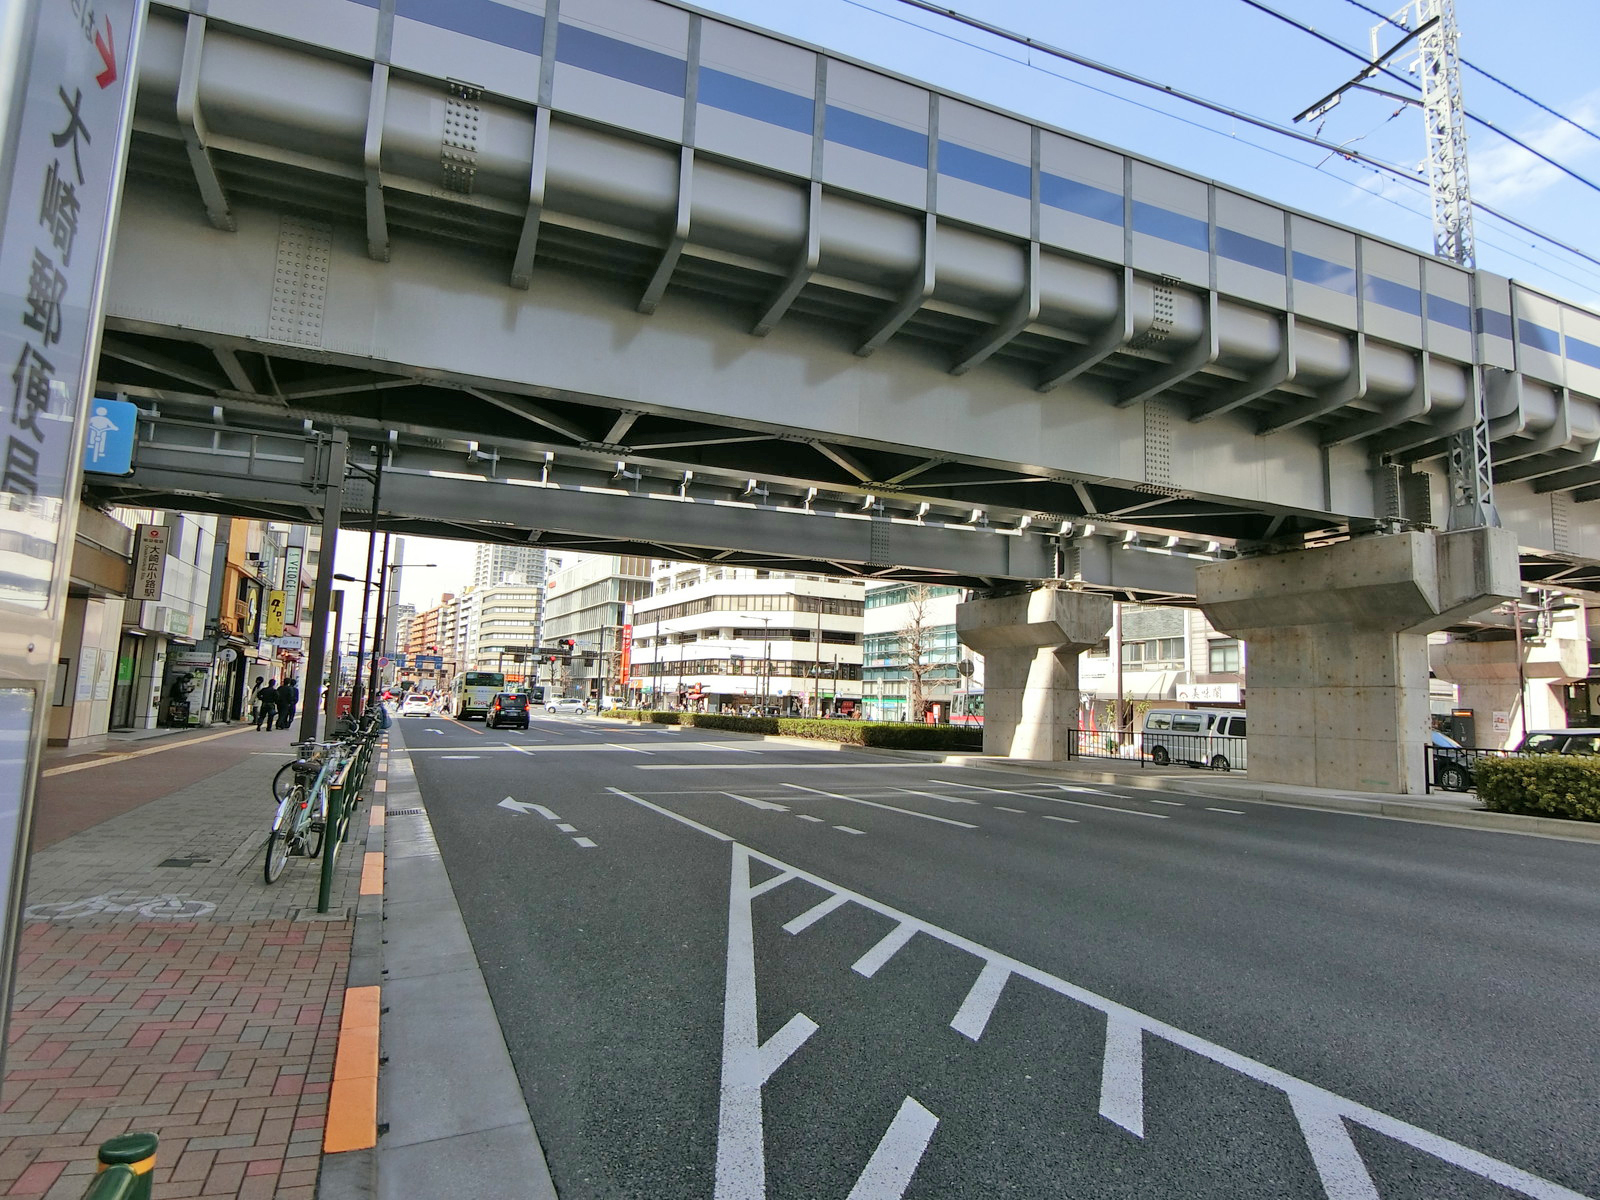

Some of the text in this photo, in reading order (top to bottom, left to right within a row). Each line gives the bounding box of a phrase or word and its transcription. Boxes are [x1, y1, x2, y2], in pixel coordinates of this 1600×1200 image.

[144, 545, 160, 598] 大崎広小路駅
[286, 560, 299, 588] VELOCE
